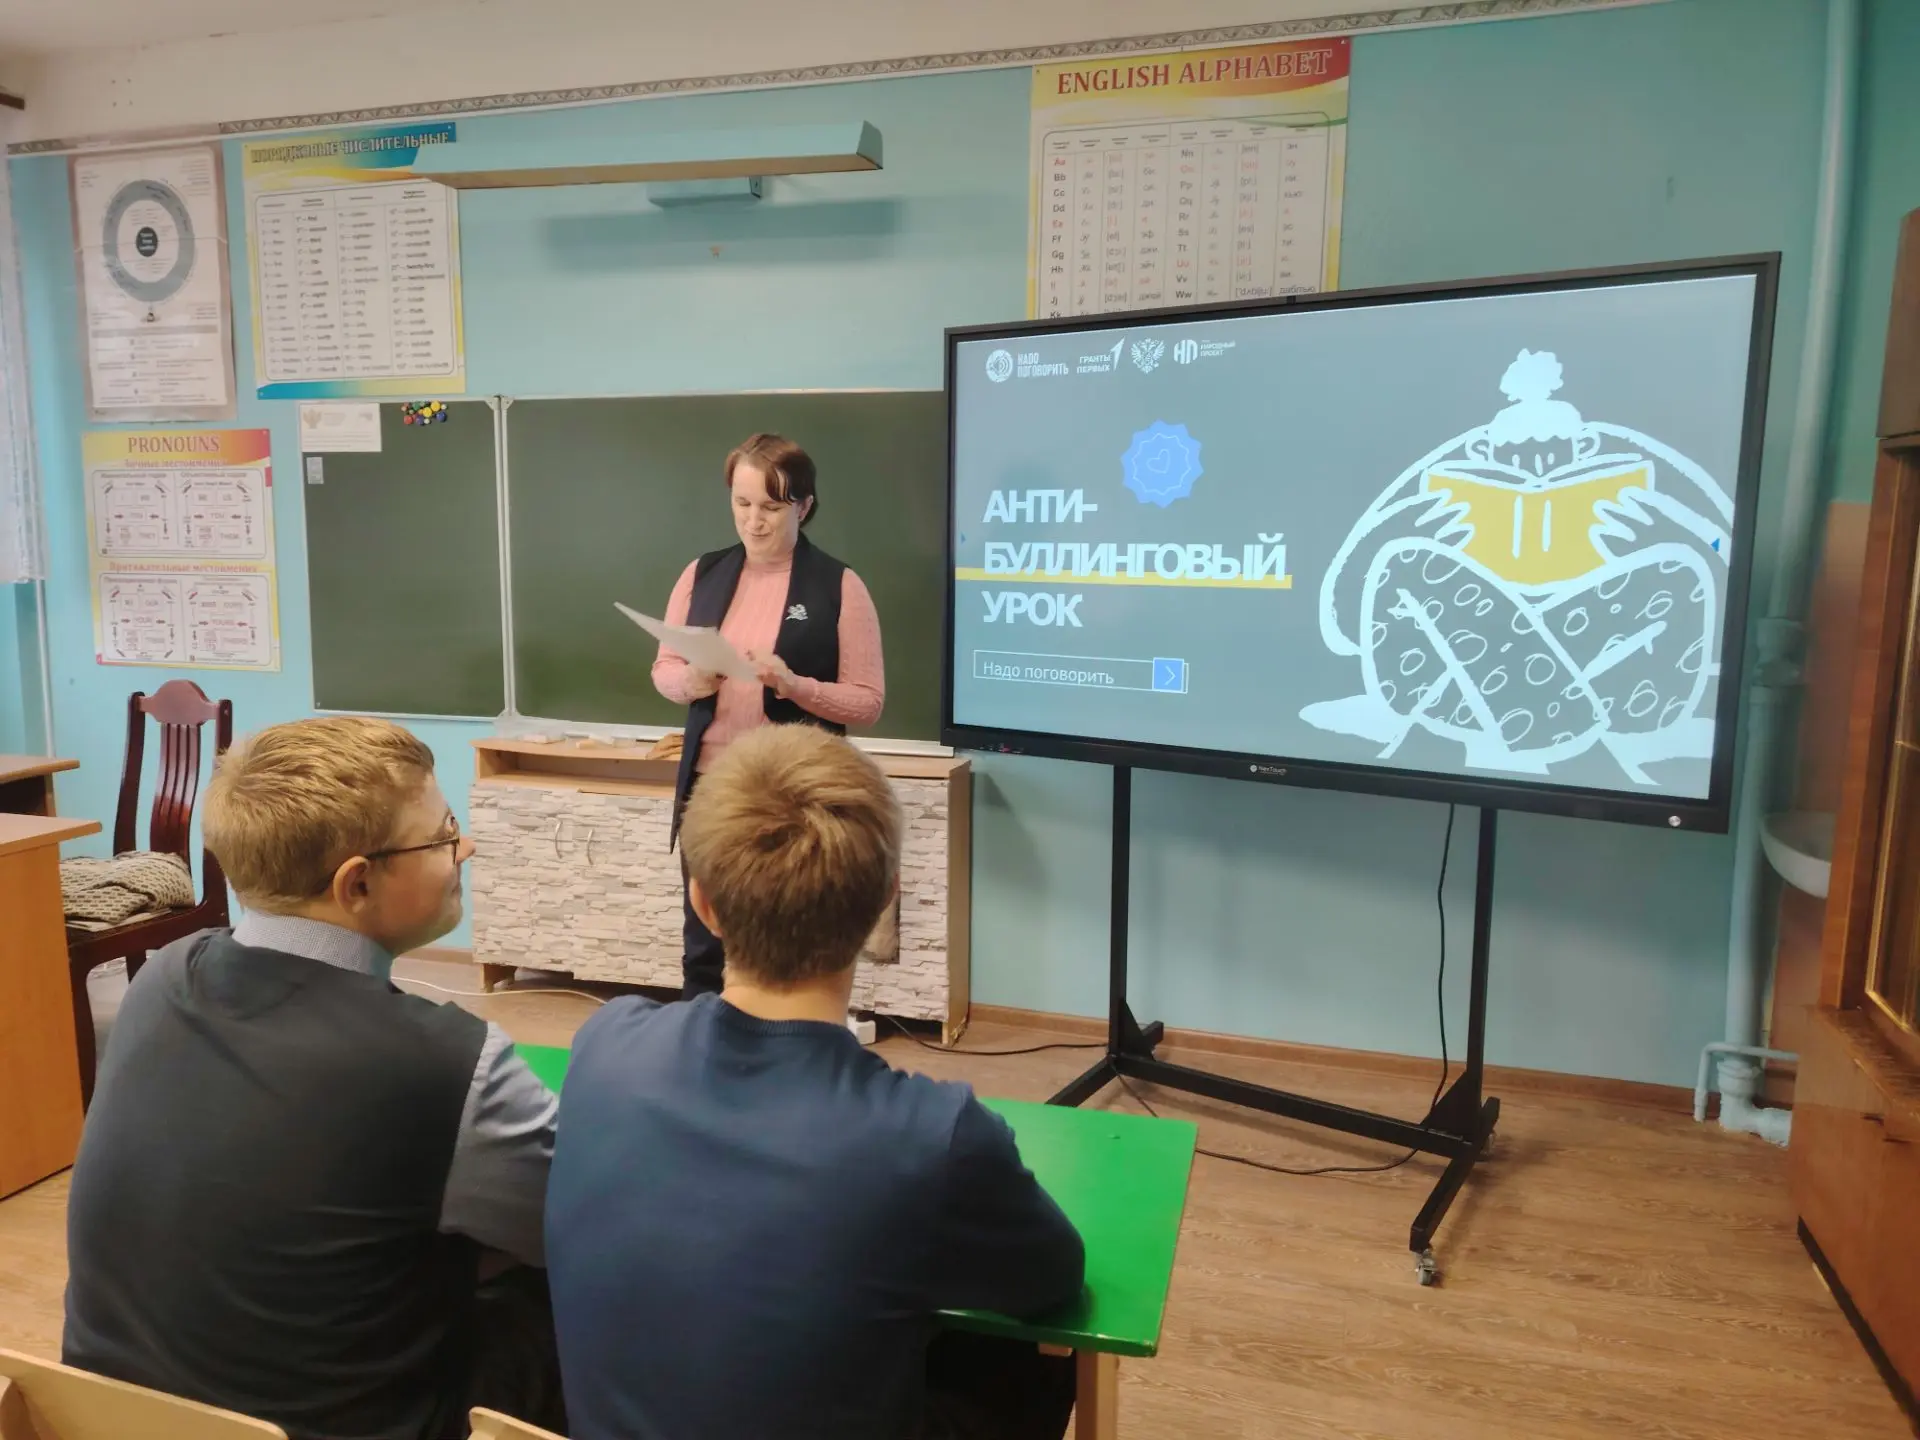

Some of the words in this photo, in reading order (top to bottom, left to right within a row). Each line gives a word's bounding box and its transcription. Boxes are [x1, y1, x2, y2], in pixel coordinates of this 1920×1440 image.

[1057, 64, 1170, 95] ENGLISH
[1179, 49, 1332, 84] ALPHABET
[340, 132, 449, 154] ЧИСЛИТЕЛЬНЫЕ
[1053, 204, 1065, 213] Dd
[1051, 250, 1064, 260] Gg
[1051, 266, 1064, 274] Hh
[1017, 352, 1039, 365] НАДО
[1080, 354, 1111, 364] ГРАНТЫ
[1017, 363, 1069, 378] ПОГОВОРИТЬ
[1076, 364, 1110, 374] ПЕРВЫХ
[128, 436, 220, 453] PRONOUNS
[982, 488, 1098, 523] АНТИ-
[984, 532, 1287, 581] БУЛЛИНГОВЫЙ
[981, 590, 1083, 627] УРОК
[983, 661, 1020, 680] Надо
[1024, 667, 1114, 685] поговорить
